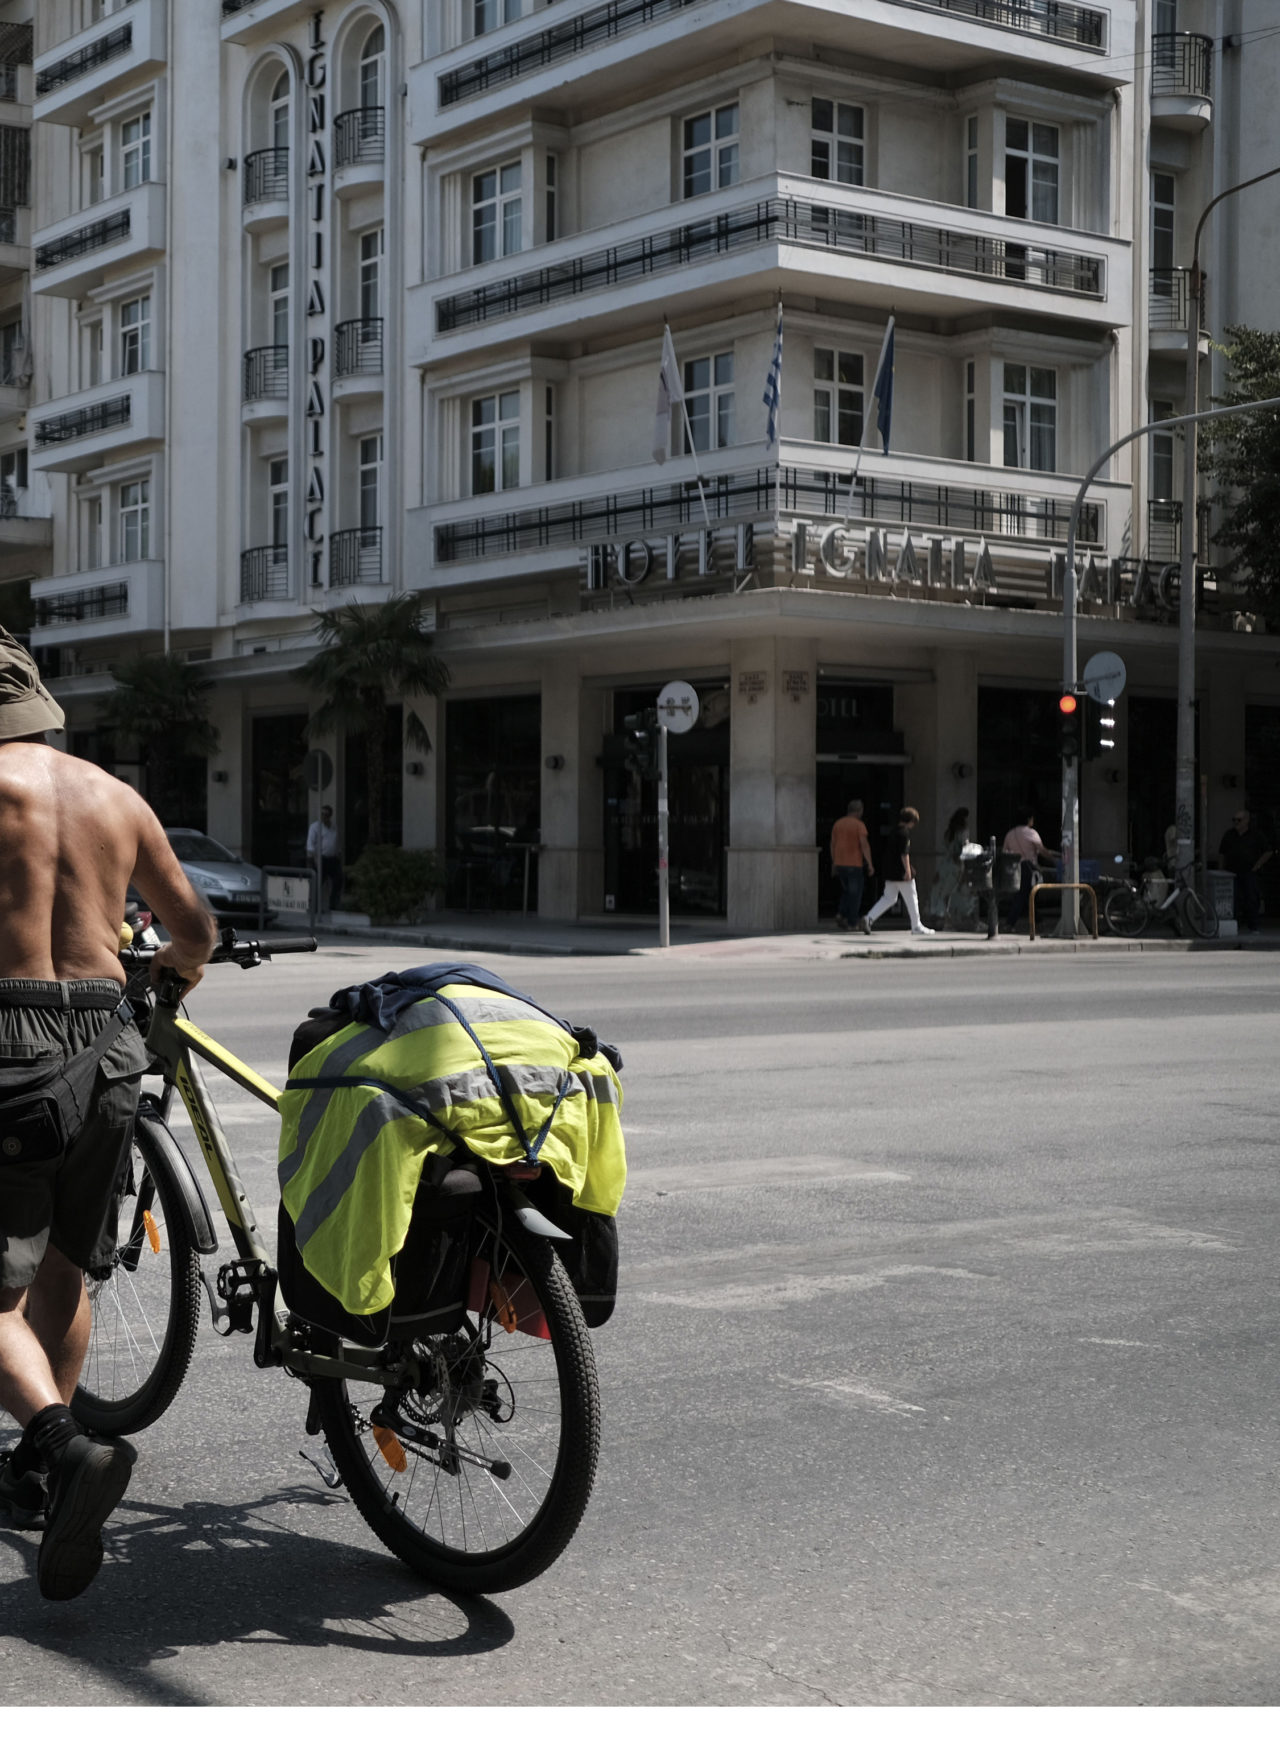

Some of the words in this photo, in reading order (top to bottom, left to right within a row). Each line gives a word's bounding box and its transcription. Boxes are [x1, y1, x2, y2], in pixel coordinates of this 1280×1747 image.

[303, 336, 326, 588] PALACE
[586, 521, 757, 584] HOTEL
[791, 517, 998, 594] EGNATIA
[180, 1075, 213, 1161] IDEAL
